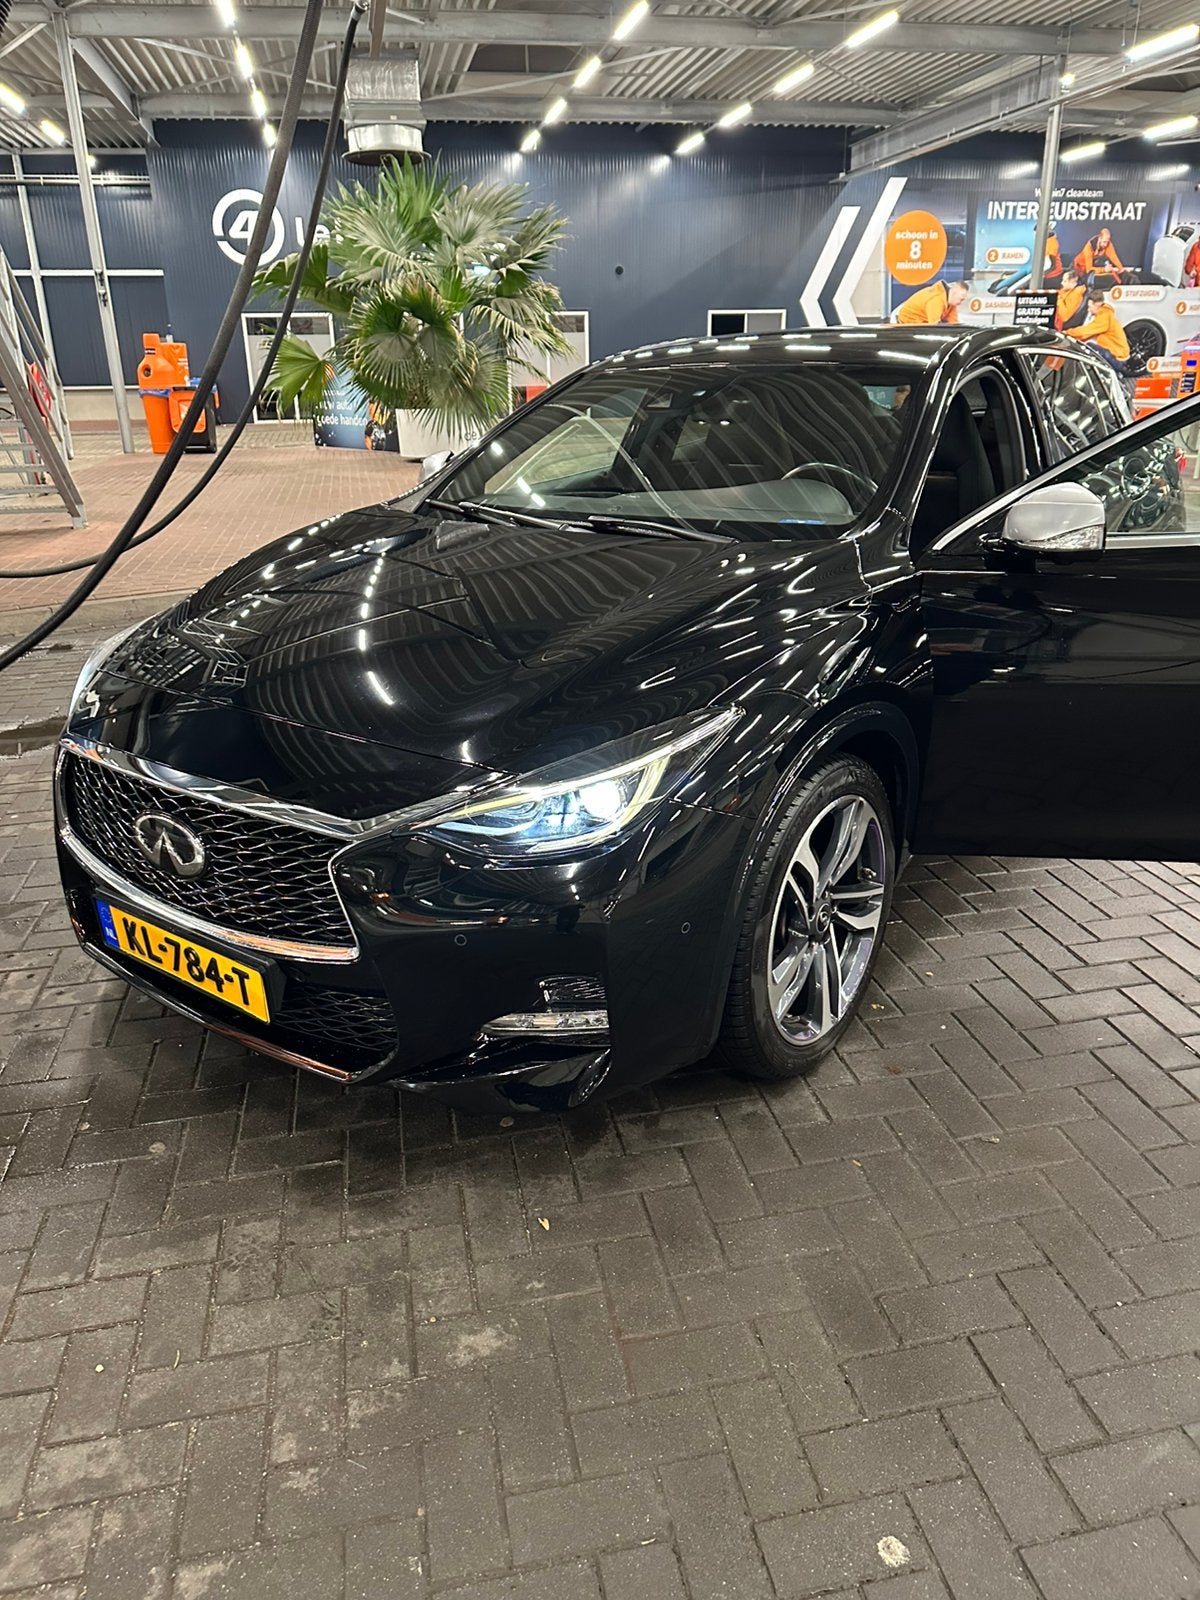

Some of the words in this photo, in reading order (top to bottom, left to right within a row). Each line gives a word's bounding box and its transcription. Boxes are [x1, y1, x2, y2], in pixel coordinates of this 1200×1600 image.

[1066, 188, 1104, 198] cleanteam
[987, 201, 1147, 221] INTEREURSTRAAT
[895, 230, 928, 240] schoon
[929, 229, 939, 240] in
[909, 240, 922, 260] 8
[896, 260, 933, 270] minuten
[1018, 297, 1048, 305] UITGANG
[1016, 308, 1041, 316] GRATIS
[339, 414, 368, 426] handen
[105, 926, 118, 940] NL
[122, 916, 250, 1006] KL-784-T
